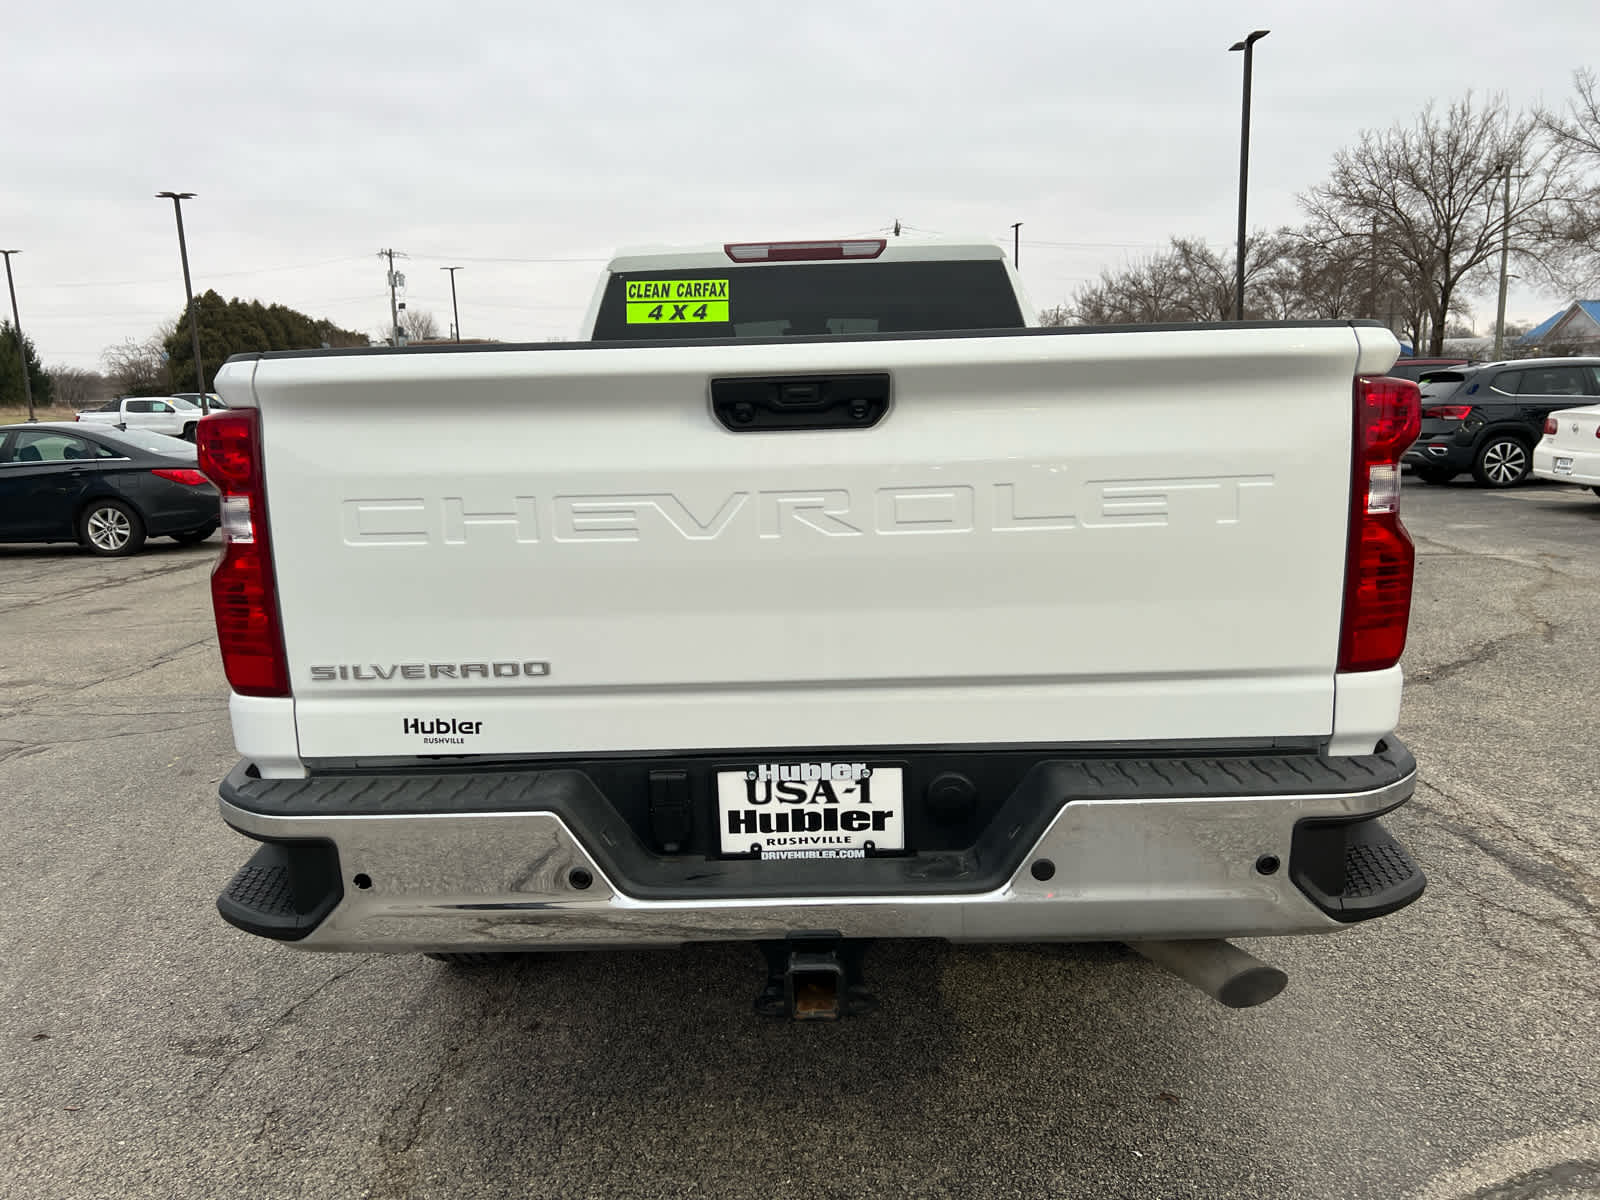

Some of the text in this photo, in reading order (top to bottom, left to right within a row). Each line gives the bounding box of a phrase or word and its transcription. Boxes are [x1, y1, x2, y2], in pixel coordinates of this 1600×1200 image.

[629, 282, 726, 298] CLEAN CARFAX
[343, 474, 1274, 545] CHEVROLET
[310, 661, 551, 680] SILVERADO
[403, 717, 483, 735] Hubler
[758, 762, 867, 781] Hubler
[746, 780, 872, 805] USA-1
[728, 808, 893, 833] Hubler
[766, 836, 852, 846] RUSHVILLE
[761, 850, 865, 860] DRIVEHUBLER.COM
